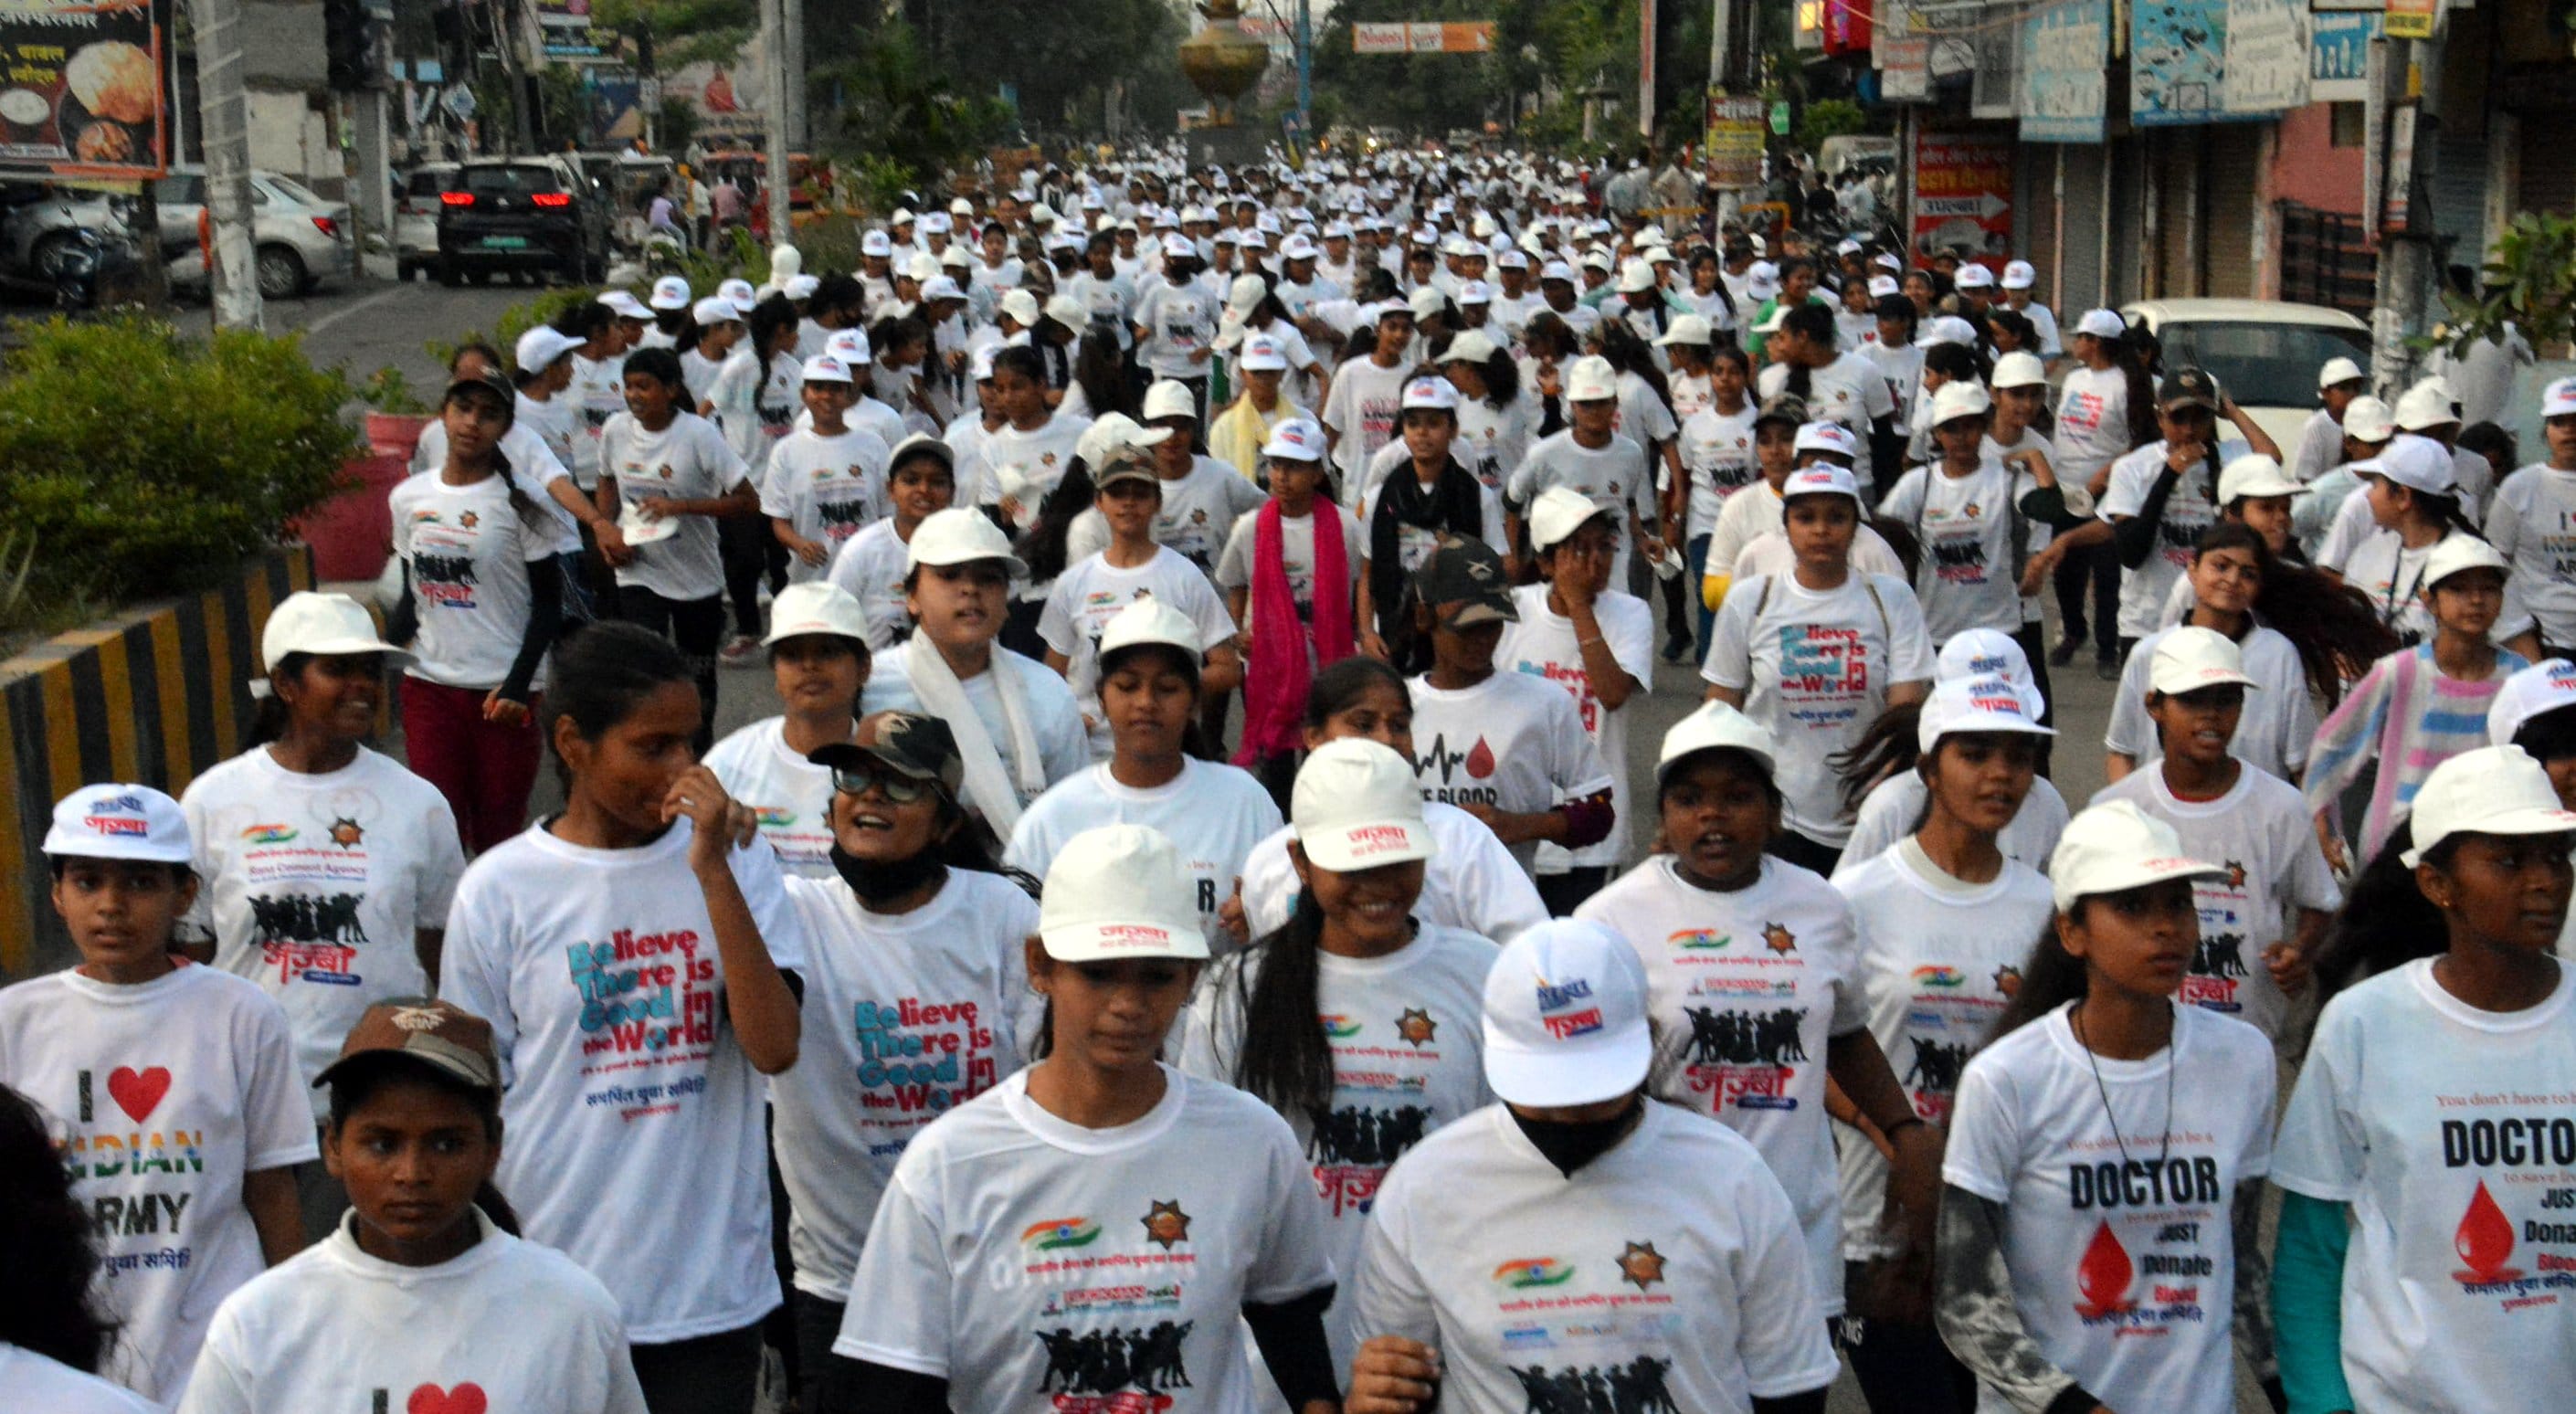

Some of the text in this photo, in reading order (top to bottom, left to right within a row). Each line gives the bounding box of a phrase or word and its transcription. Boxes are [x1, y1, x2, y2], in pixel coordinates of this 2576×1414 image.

[567, 928, 698, 970] Believe
[572, 965, 677, 1003] There
[579, 986, 675, 1033] Good
[854, 997, 978, 1029] Believe
[611, 1014, 715, 1053] World
[856, 1029, 960, 1060] There
[857, 1053, 959, 1088] Good
[79, 1070, 92, 1123] I
[64, 1130, 203, 1178] NDIAN
[2442, 1118, 2576, 1168] DOCTO
[2070, 1156, 2220, 1210] DOCTOR
[2540, 1188, 2576, 1208] JUS
[93, 1193, 191, 1236] RMY
[2525, 1219, 2576, 1243] Dona
[2143, 1254, 2213, 1277] Donate
